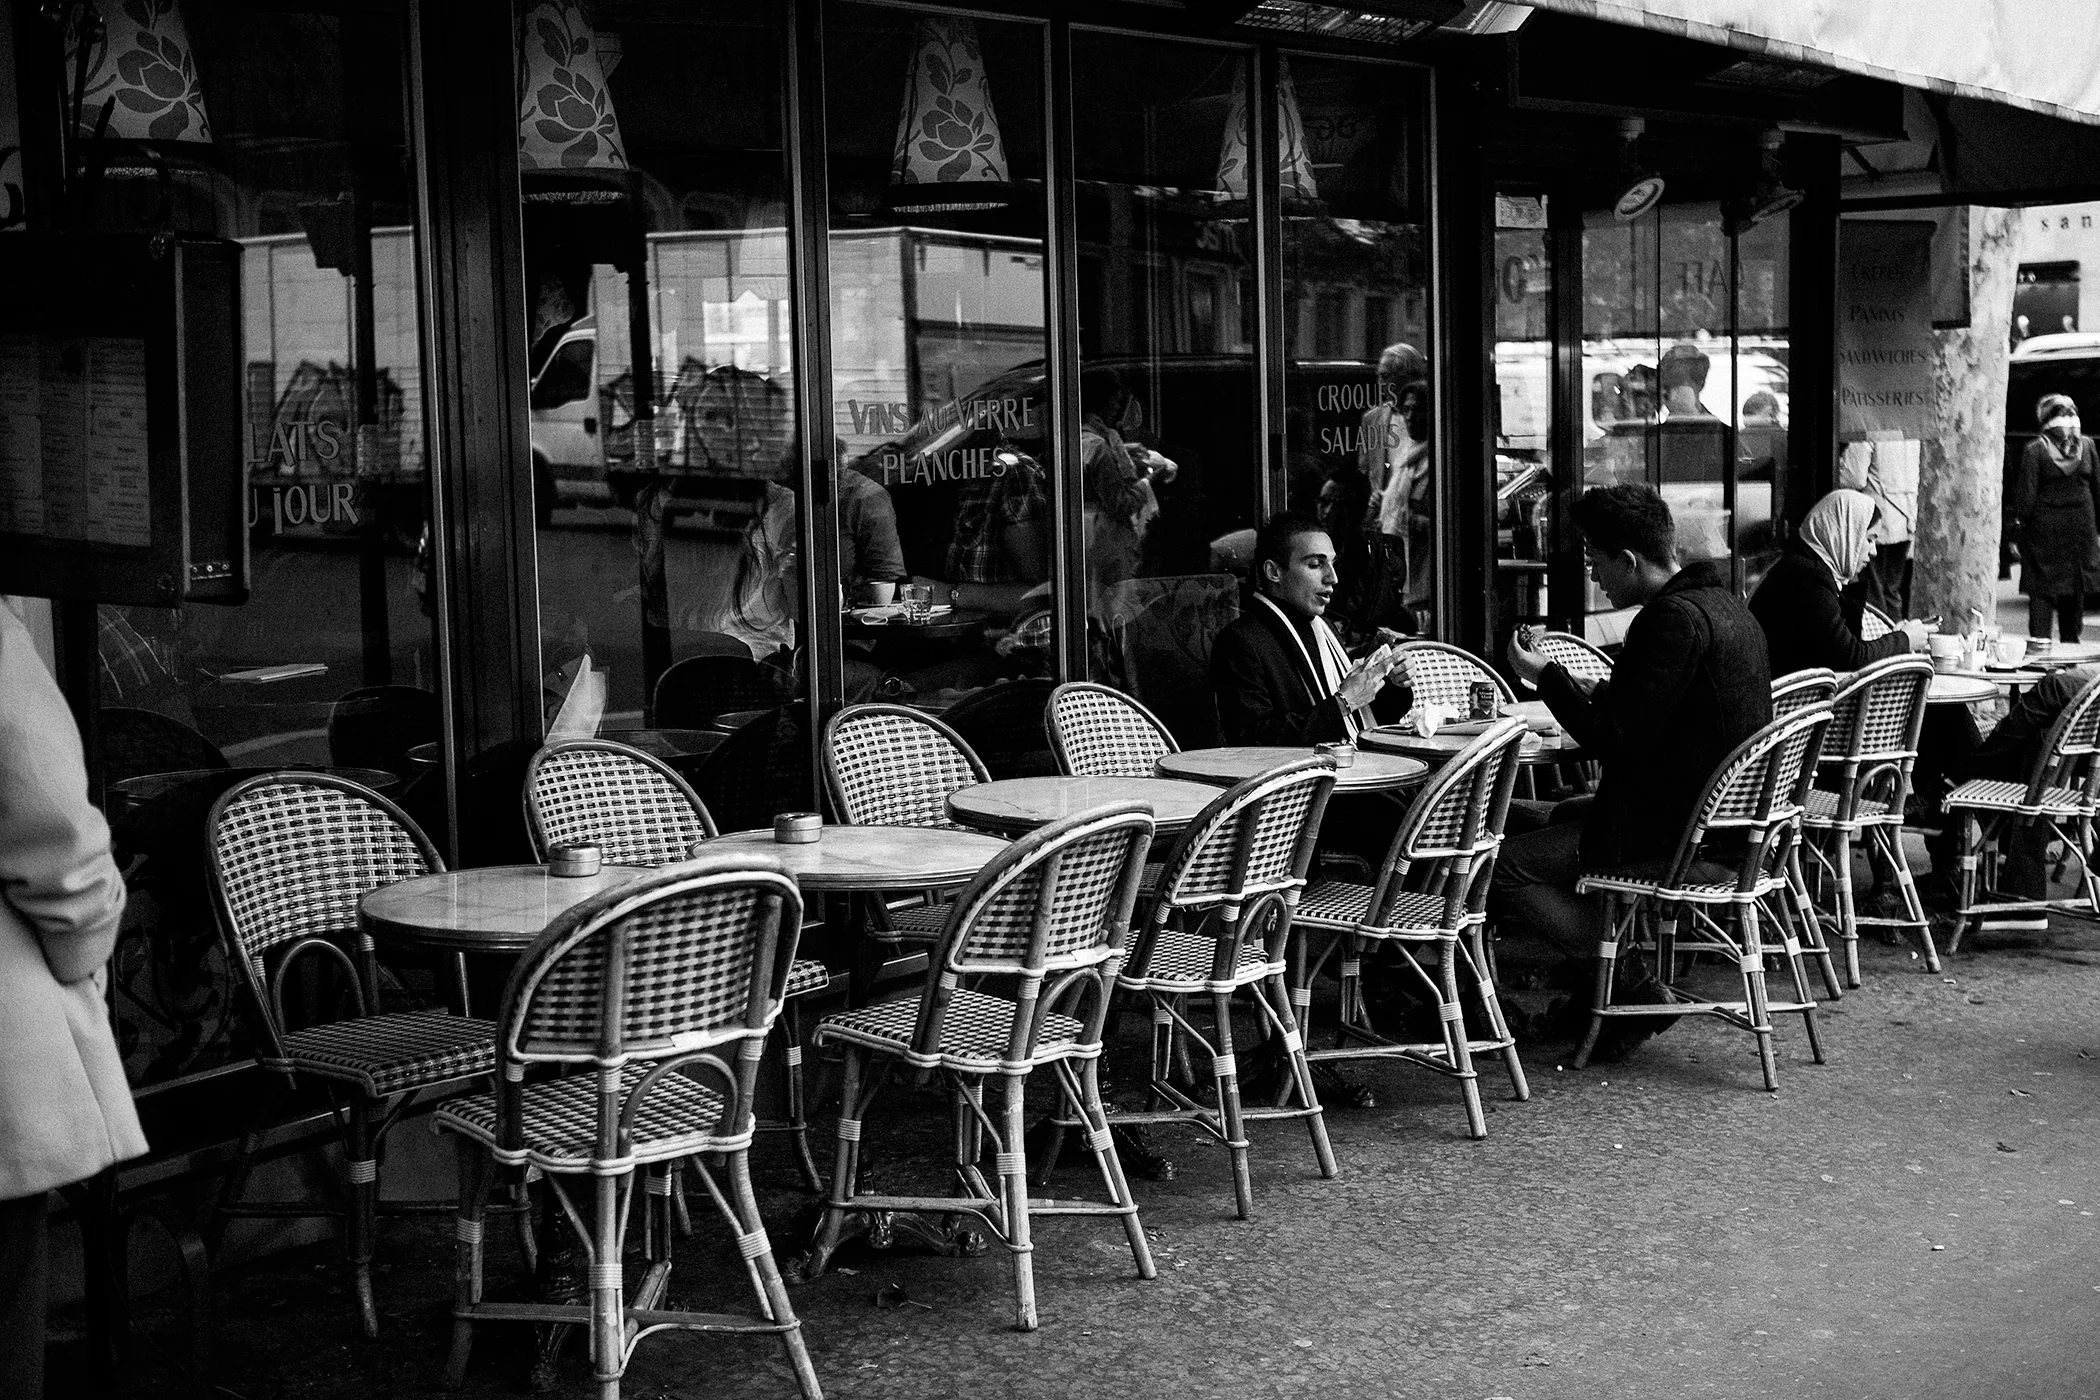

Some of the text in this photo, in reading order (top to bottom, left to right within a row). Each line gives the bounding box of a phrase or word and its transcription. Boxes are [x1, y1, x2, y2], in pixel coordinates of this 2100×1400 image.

[918, 407, 949, 436] AU
[953, 396, 1035, 432] VERRE
[1317, 382, 1399, 414] CROQUES
[1319, 423, 1401, 456] SALADES
[882, 447, 1008, 487] PLANCHES
